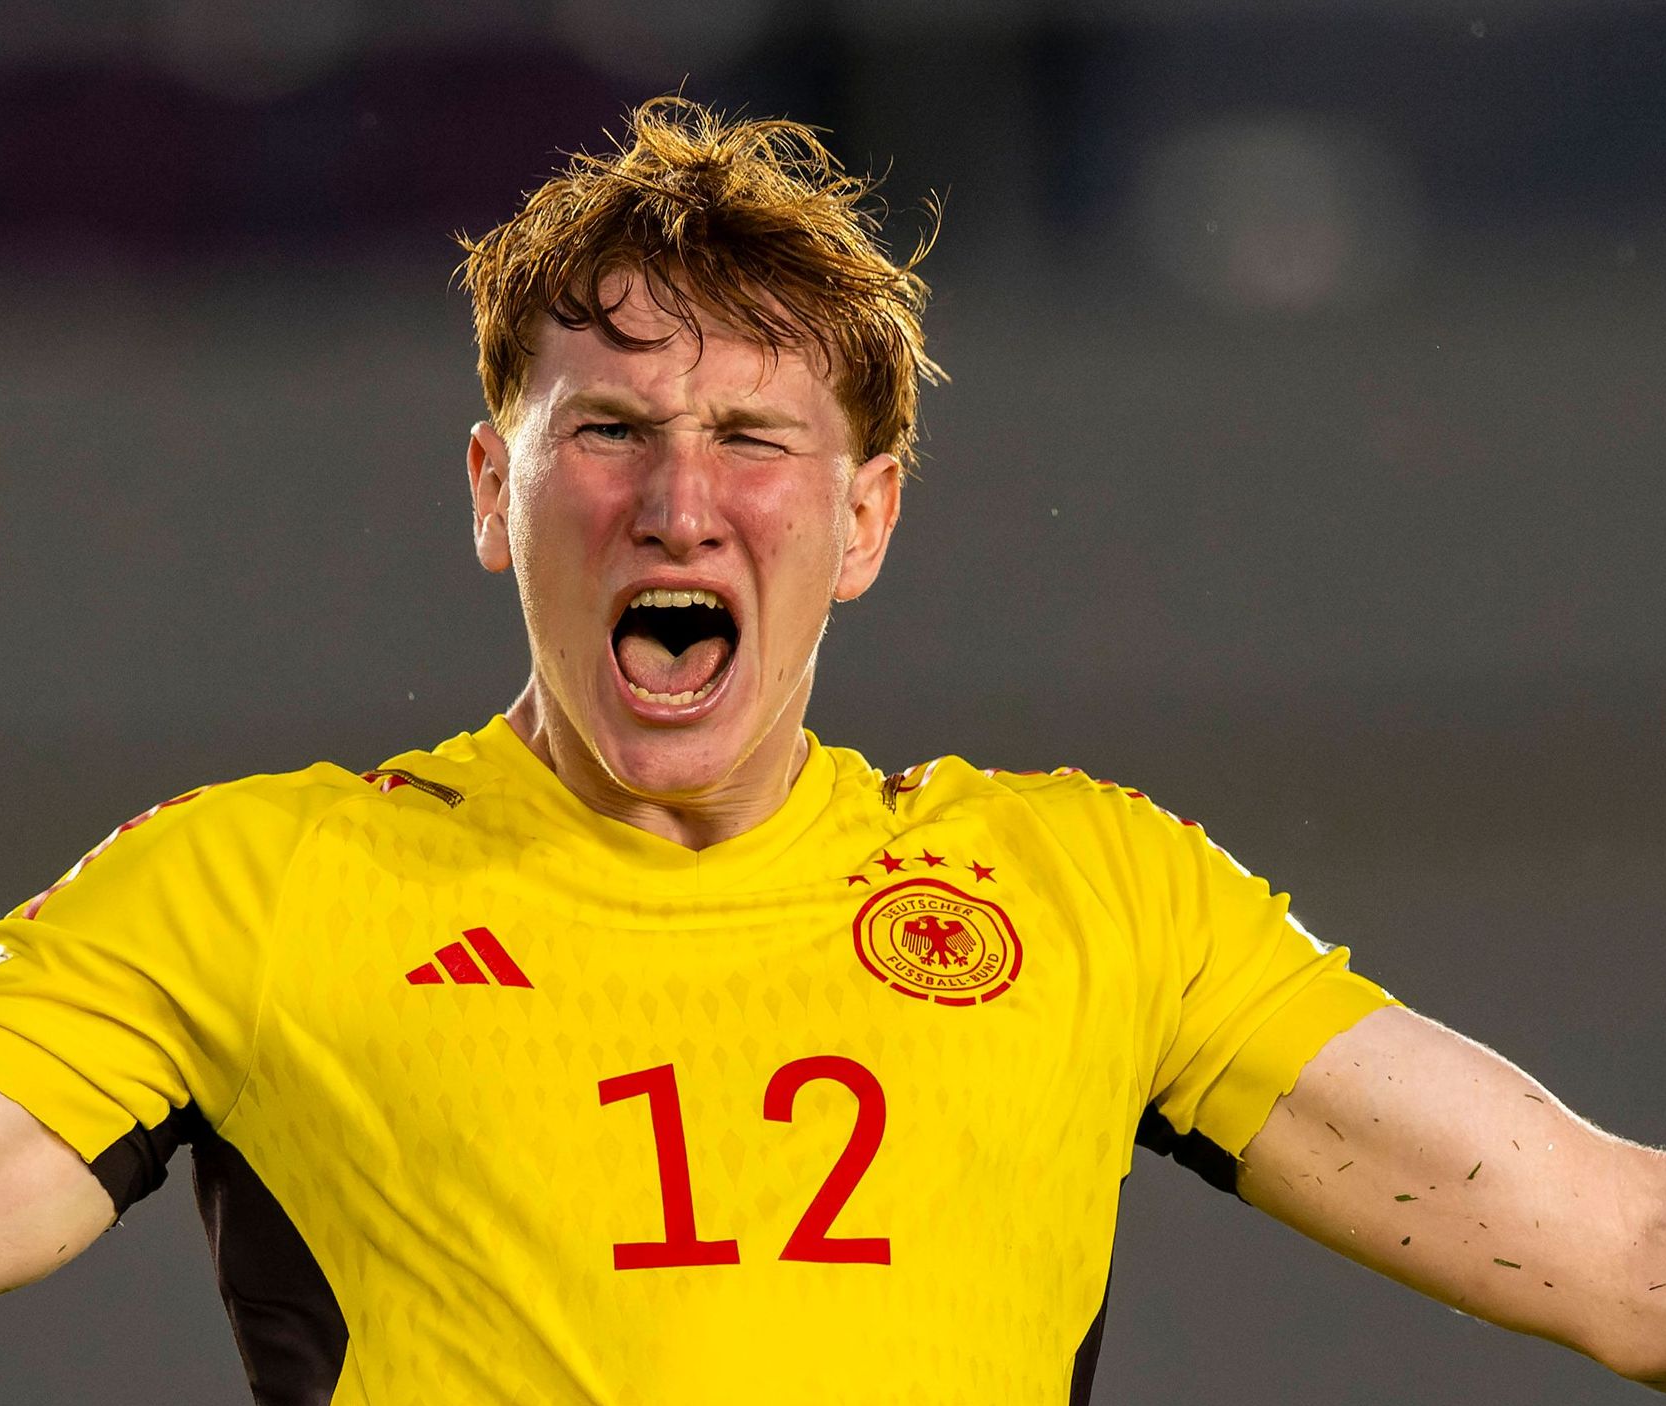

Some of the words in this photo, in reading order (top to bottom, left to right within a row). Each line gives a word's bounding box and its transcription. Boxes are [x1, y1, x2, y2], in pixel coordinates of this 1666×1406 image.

[882, 899, 974, 919] DEUTSCHER
[886, 952, 1000, 987] FUSSBALL-BUND
[597, 1055, 891, 1270] 12
